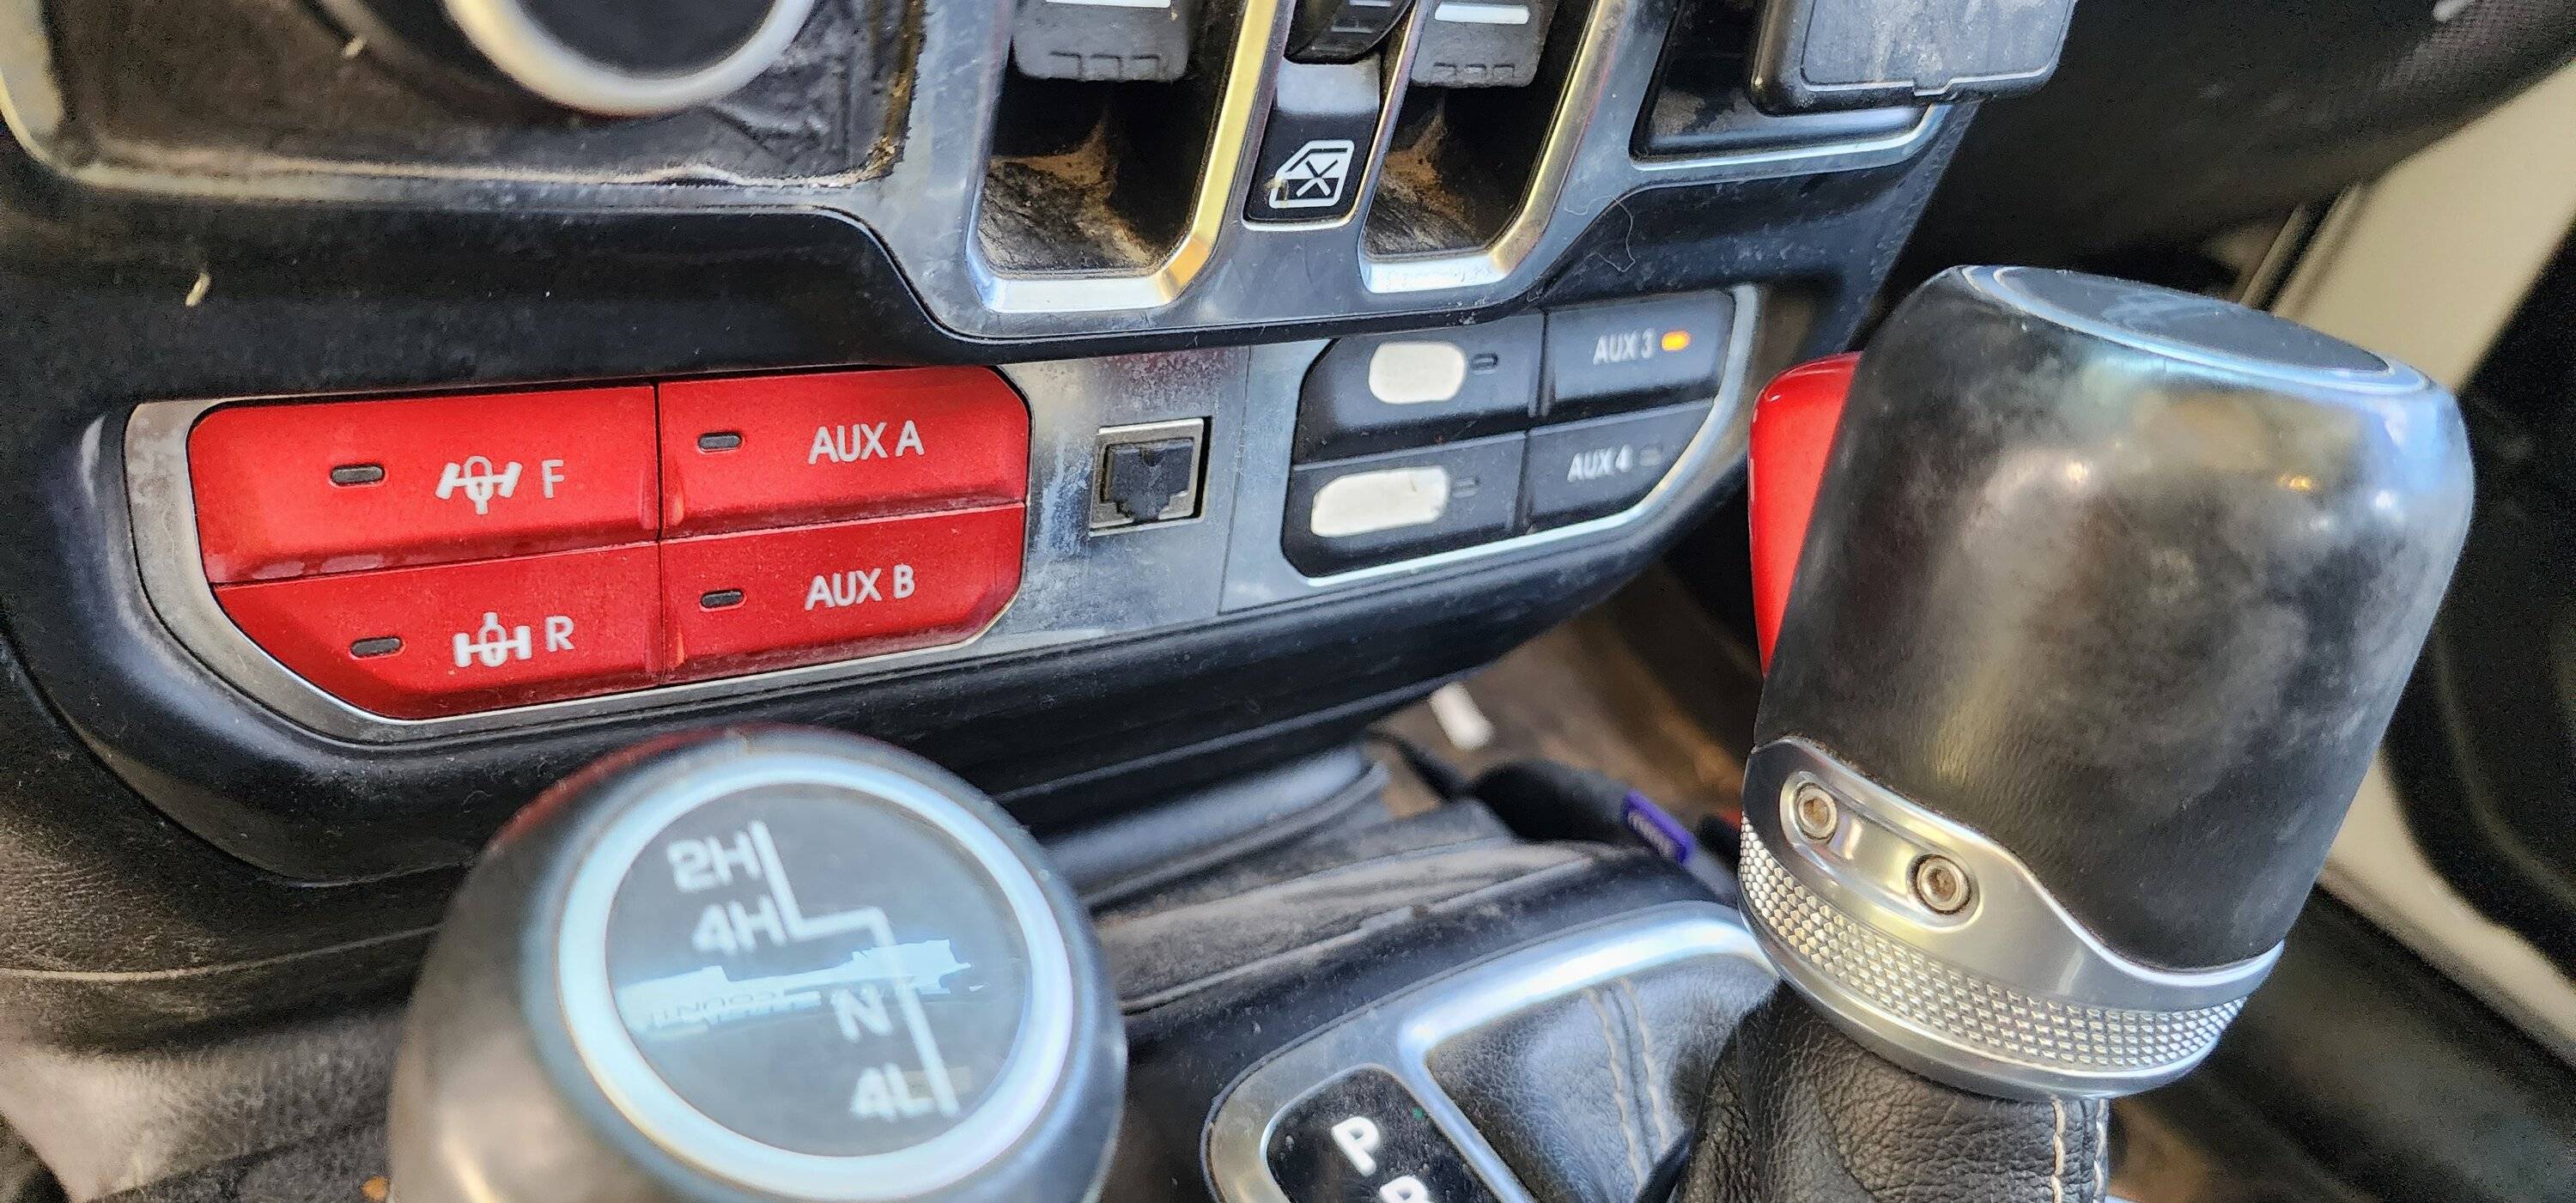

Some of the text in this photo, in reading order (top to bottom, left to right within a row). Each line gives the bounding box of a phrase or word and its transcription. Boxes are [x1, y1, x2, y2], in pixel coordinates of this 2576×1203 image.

[1592, 327, 1657, 365] AUX 3
[807, 419, 925, 465] AUX A
[1566, 443, 1632, 483] AUX 4
[540, 459, 565, 499] F
[804, 563, 916, 611] AUX B
[544, 614, 575, 653] R
[666, 829, 762, 893] 2H
[690, 894, 787, 957] 4H
[829, 983, 894, 1043] N
[848, 1060, 936, 1123] 4L
[1331, 1115, 1380, 1176] P
